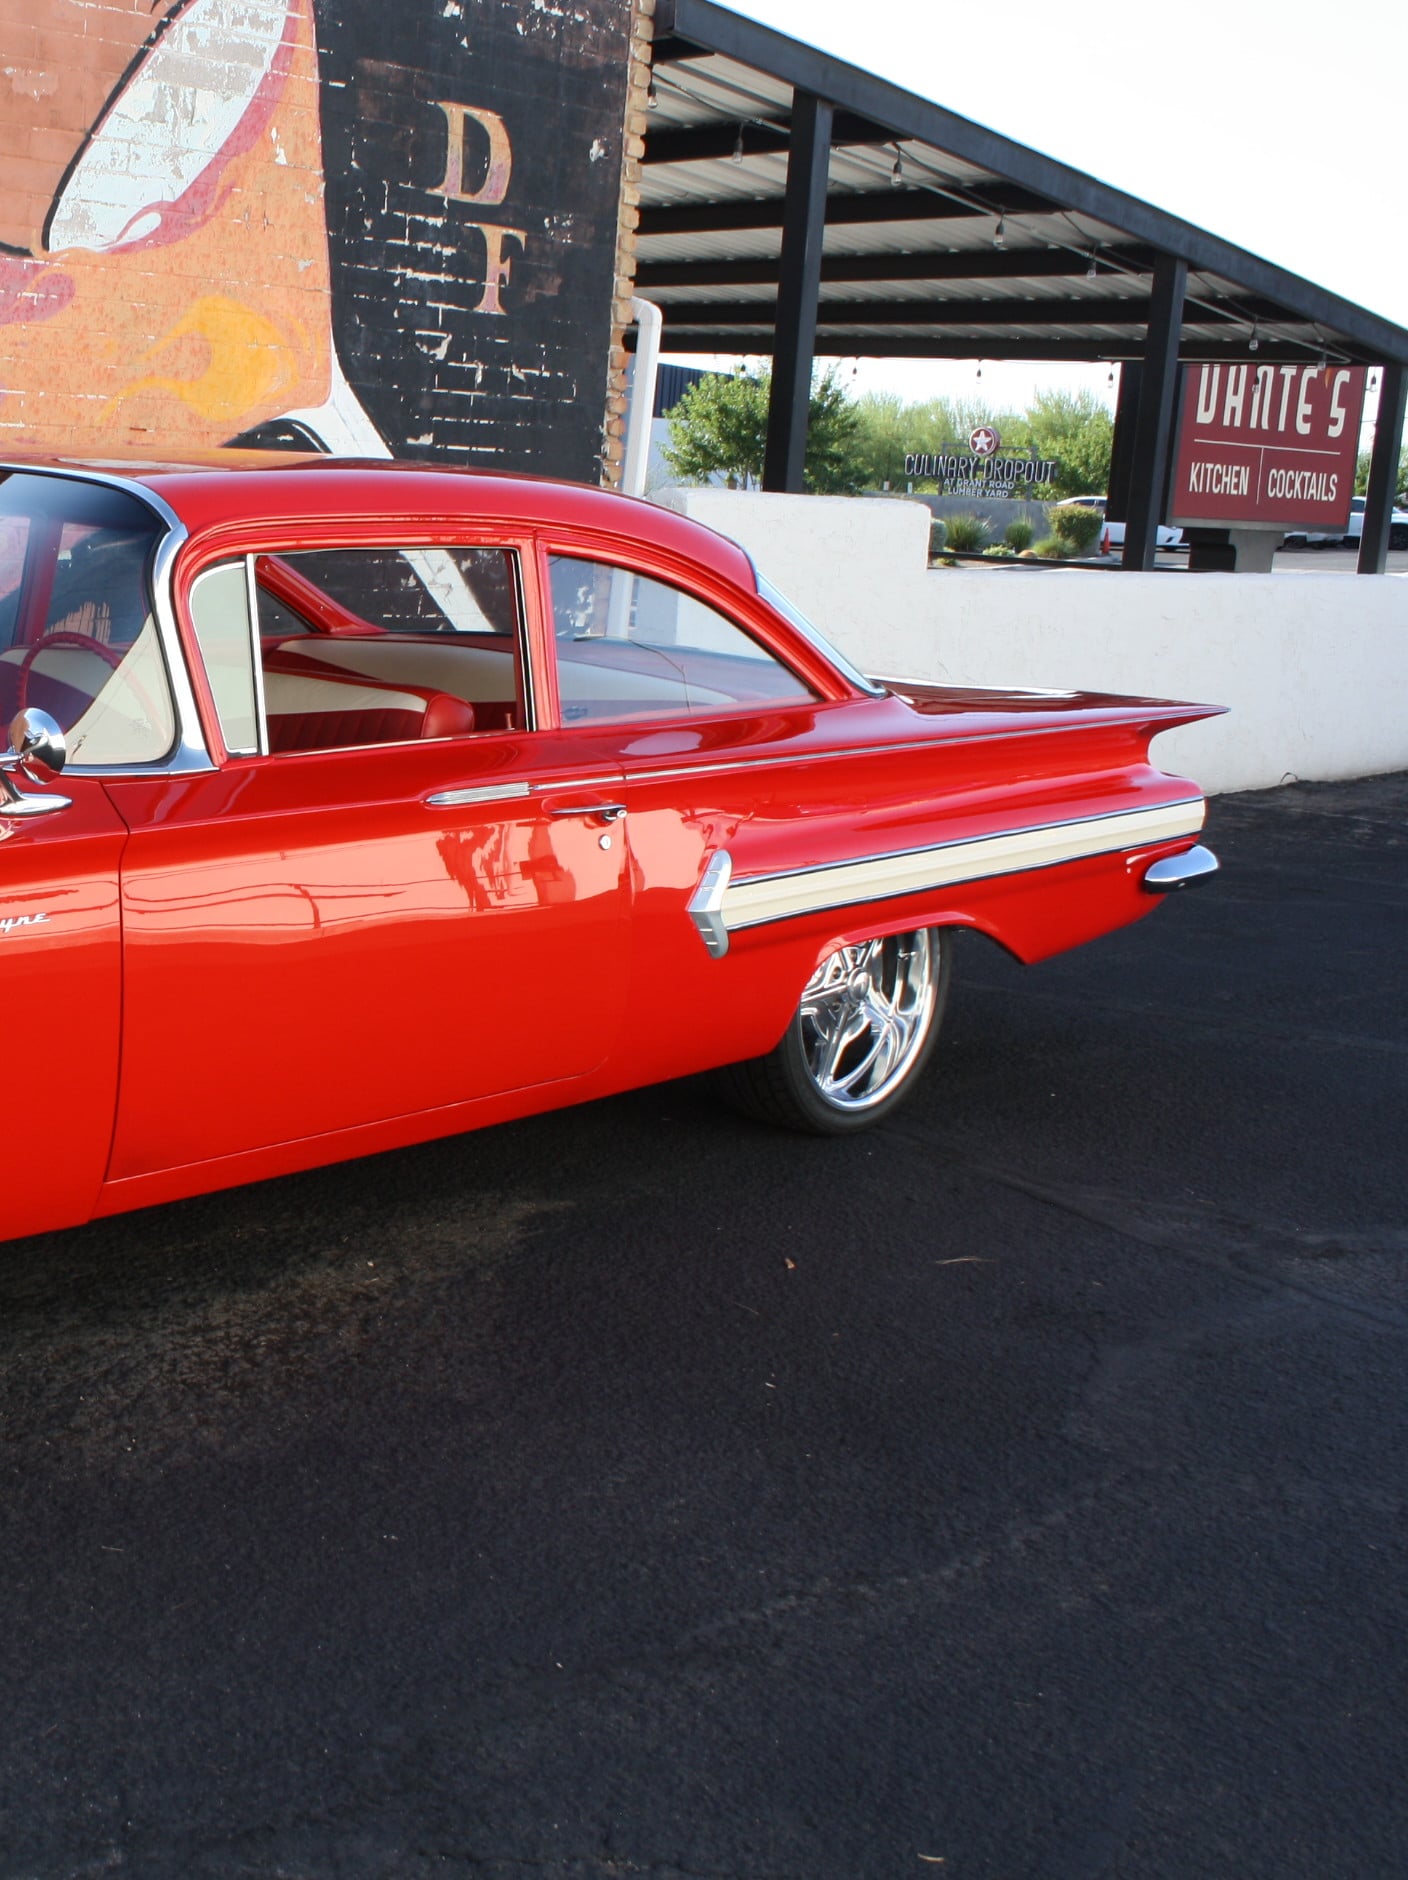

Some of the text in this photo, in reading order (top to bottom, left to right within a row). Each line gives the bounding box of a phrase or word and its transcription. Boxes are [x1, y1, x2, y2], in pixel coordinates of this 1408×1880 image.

[905, 454, 1057, 484] CULINARY DROPOUT
[943, 477, 955, 486] AT
[988, 480, 1015, 490] ROAD
[1189, 462, 1338, 502] KITCHEN COCKTAILS
[947, 487, 1010, 499] LUMBER YARD
